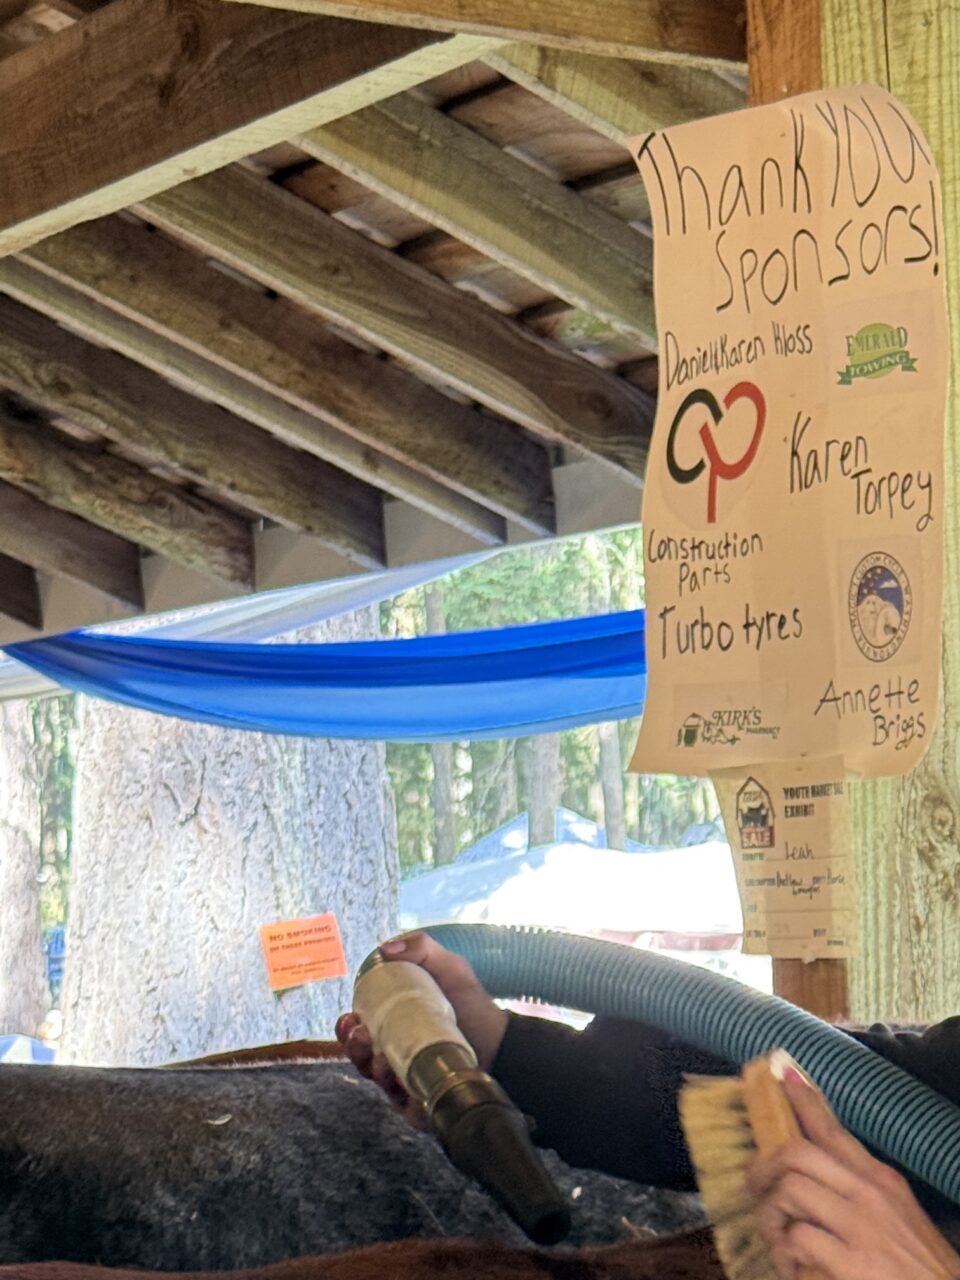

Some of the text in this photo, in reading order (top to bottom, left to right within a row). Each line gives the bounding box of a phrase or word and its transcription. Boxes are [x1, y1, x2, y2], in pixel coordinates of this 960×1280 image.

[714, 180, 939, 313] Sponsors!
[789, 411, 868, 494] Karen
[851, 467, 933, 531] Torpey
[648, 529, 764, 563] Construction
[679, 563, 731, 597] Parts
[659, 603, 734, 660] Turbo
[742, 602, 804, 651] tyres
[712, 706, 762, 731] KIRK'S
[814, 676, 920, 720] Annette
[872, 713, 926, 751] Briggs
